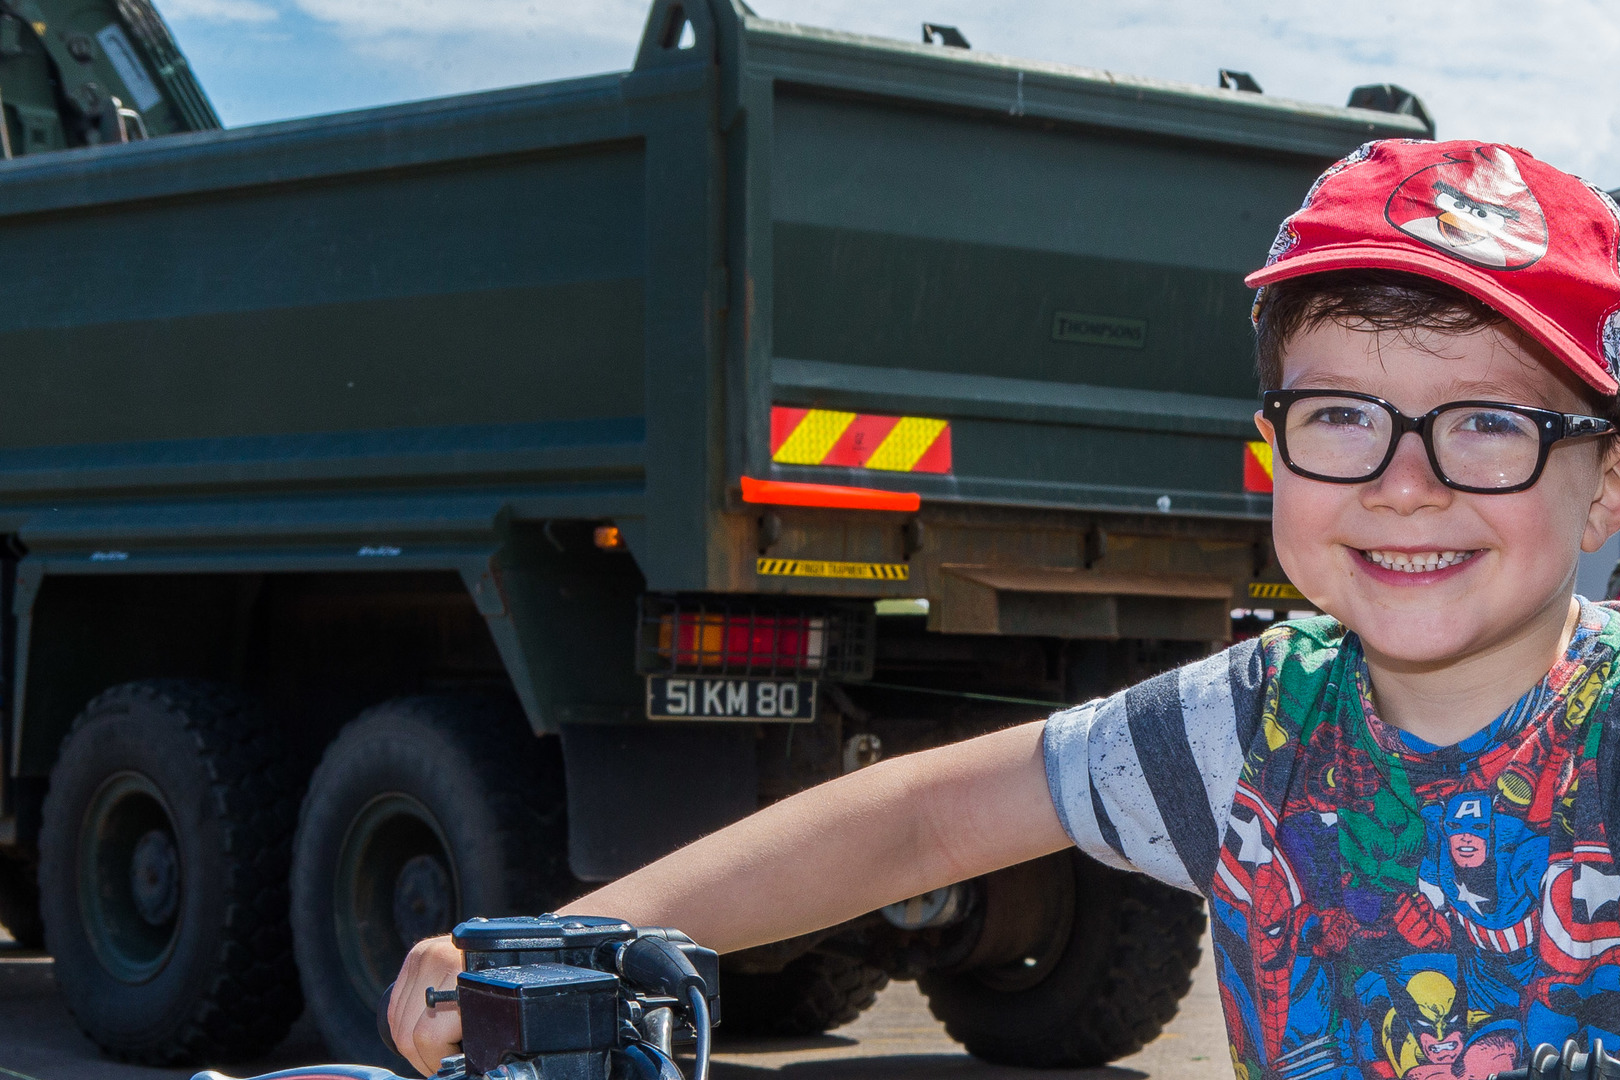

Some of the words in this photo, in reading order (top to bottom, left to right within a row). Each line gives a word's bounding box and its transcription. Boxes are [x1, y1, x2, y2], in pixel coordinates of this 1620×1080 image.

[666, 679, 695, 715] 51
[703, 680, 748, 716] KM
[756, 682, 799, 717] 80
